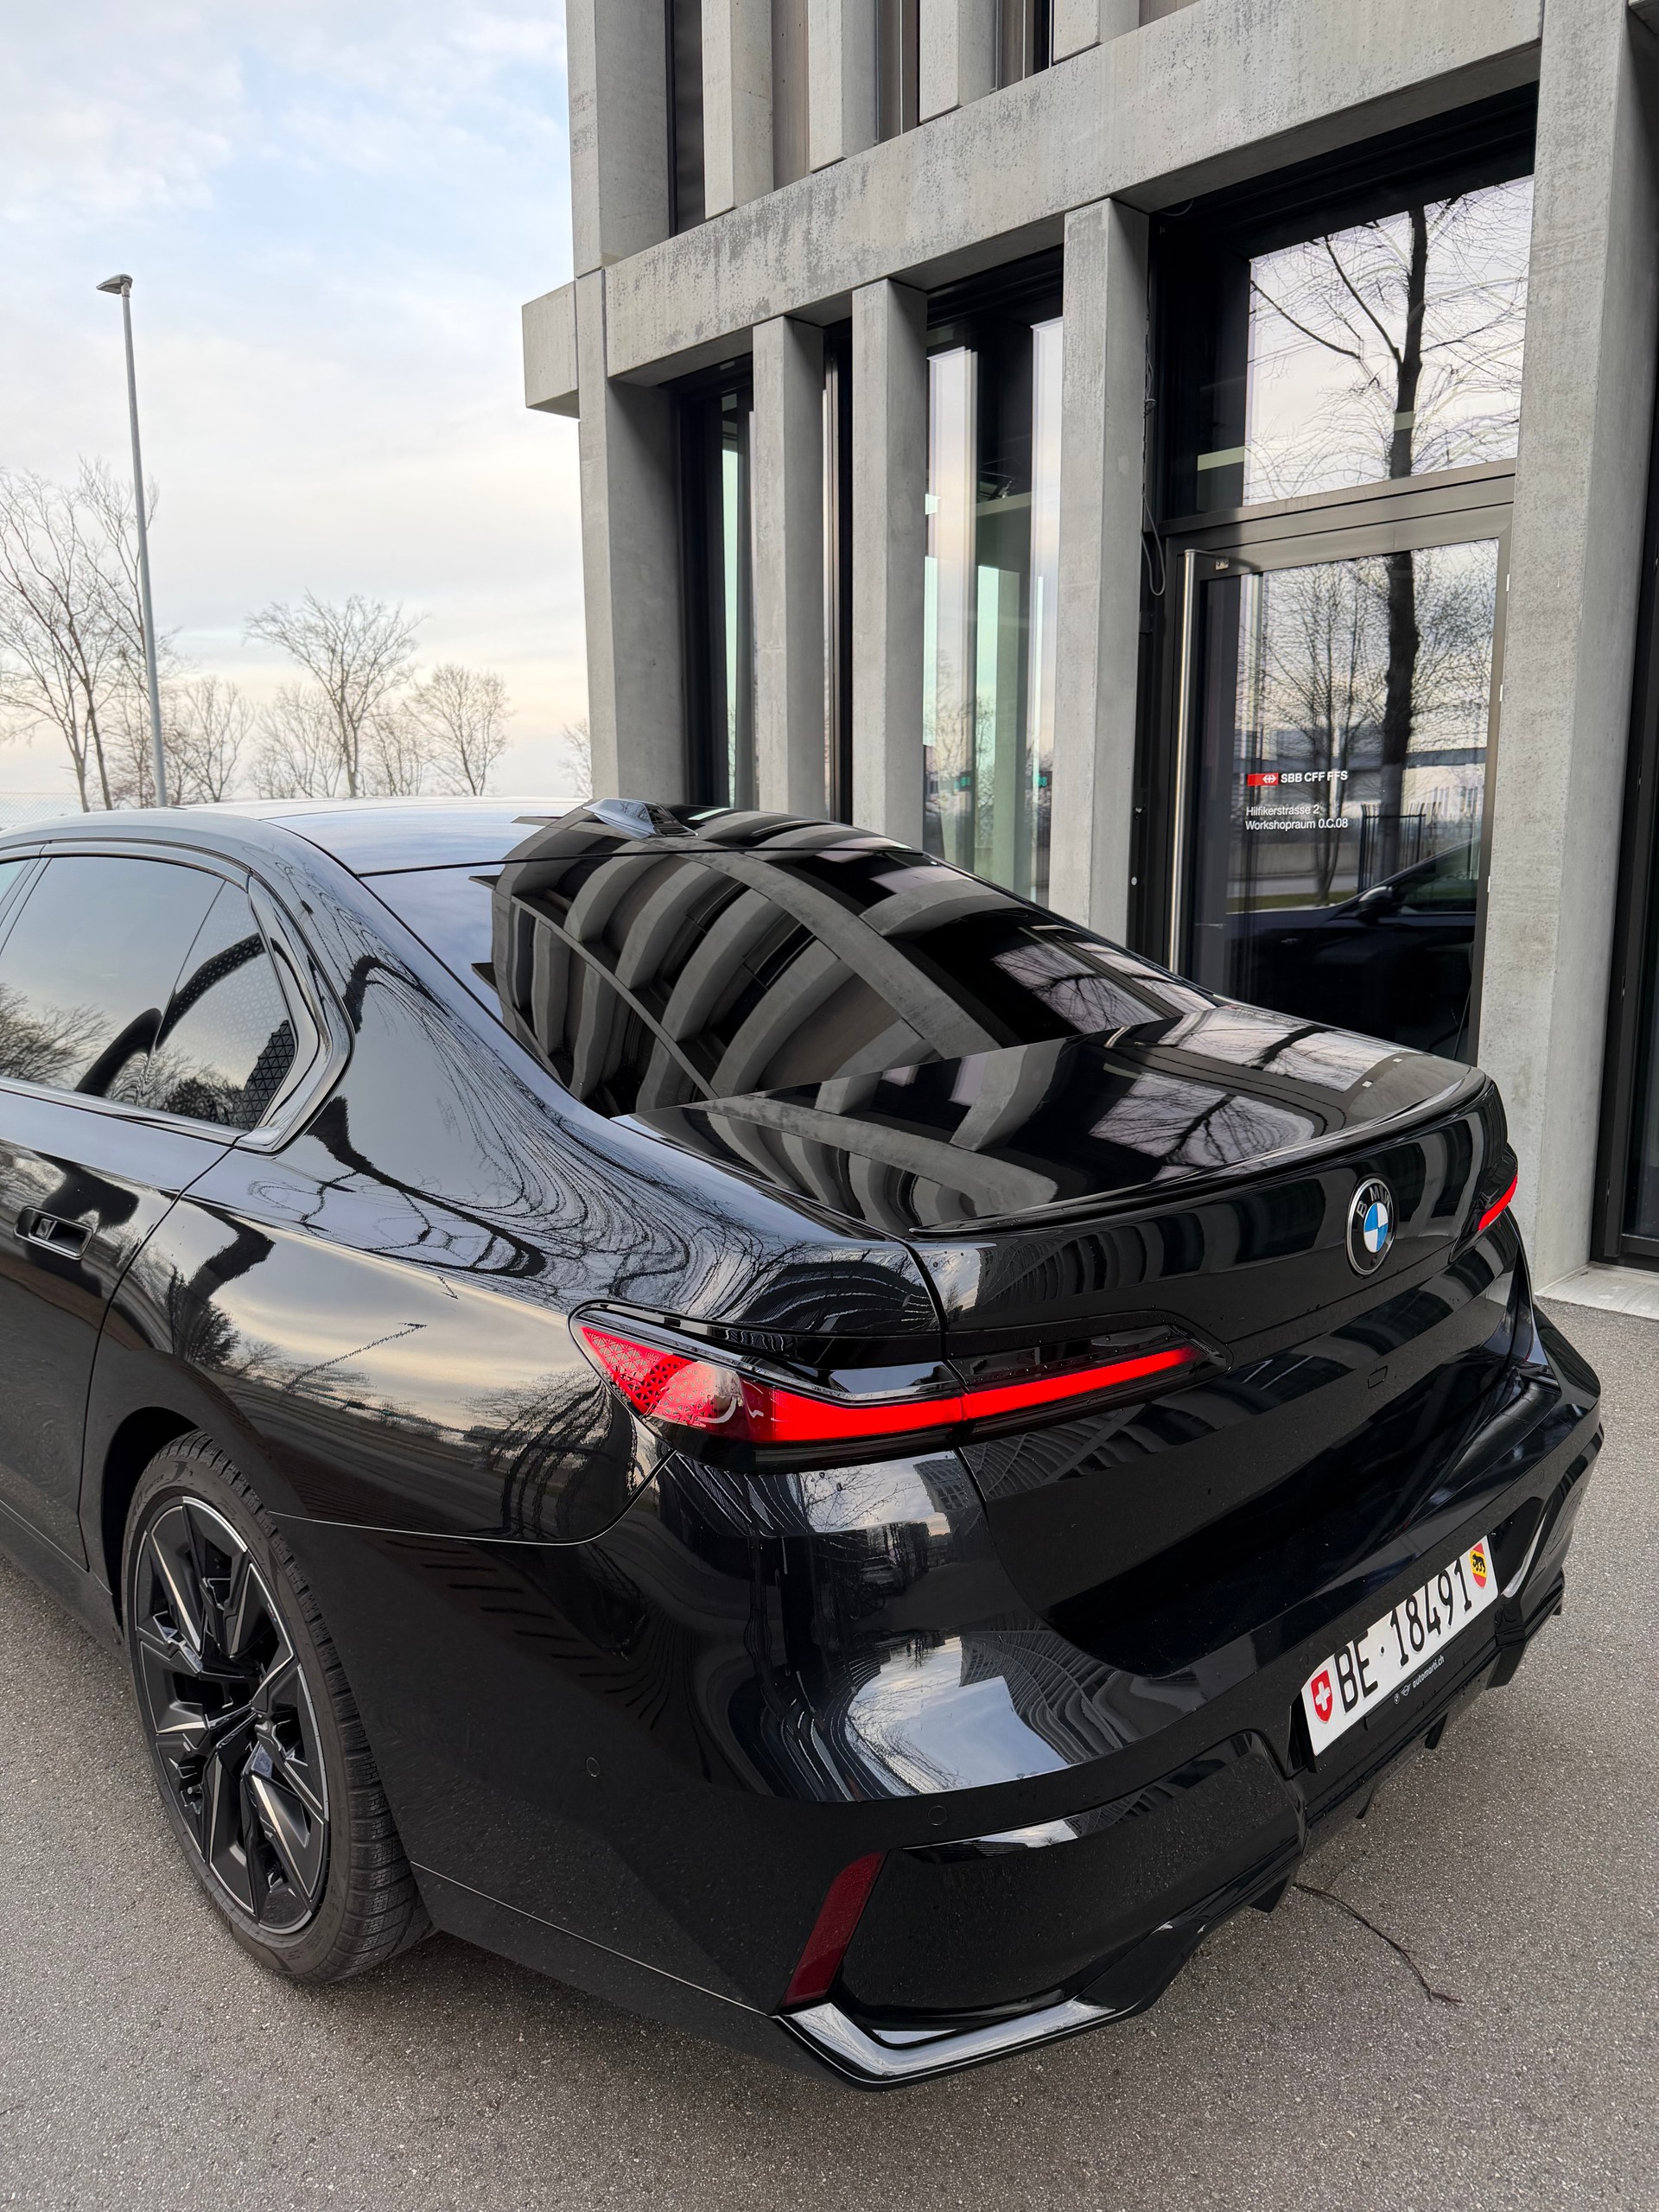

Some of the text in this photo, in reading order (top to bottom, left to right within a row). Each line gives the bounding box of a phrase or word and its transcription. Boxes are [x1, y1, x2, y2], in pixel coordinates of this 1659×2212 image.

[1281, 770, 1348, 783] SBB CFF FFS
[1246, 804, 1320, 817] Hilfikerstrasse 2
[1245, 817, 1349, 832] Workshopraum 0.C.08
[1356, 1185, 1391, 1219] BMW
[1334, 1559, 1472, 1713] BE 18491
[1412, 1655, 1445, 1688] automarti.ch
